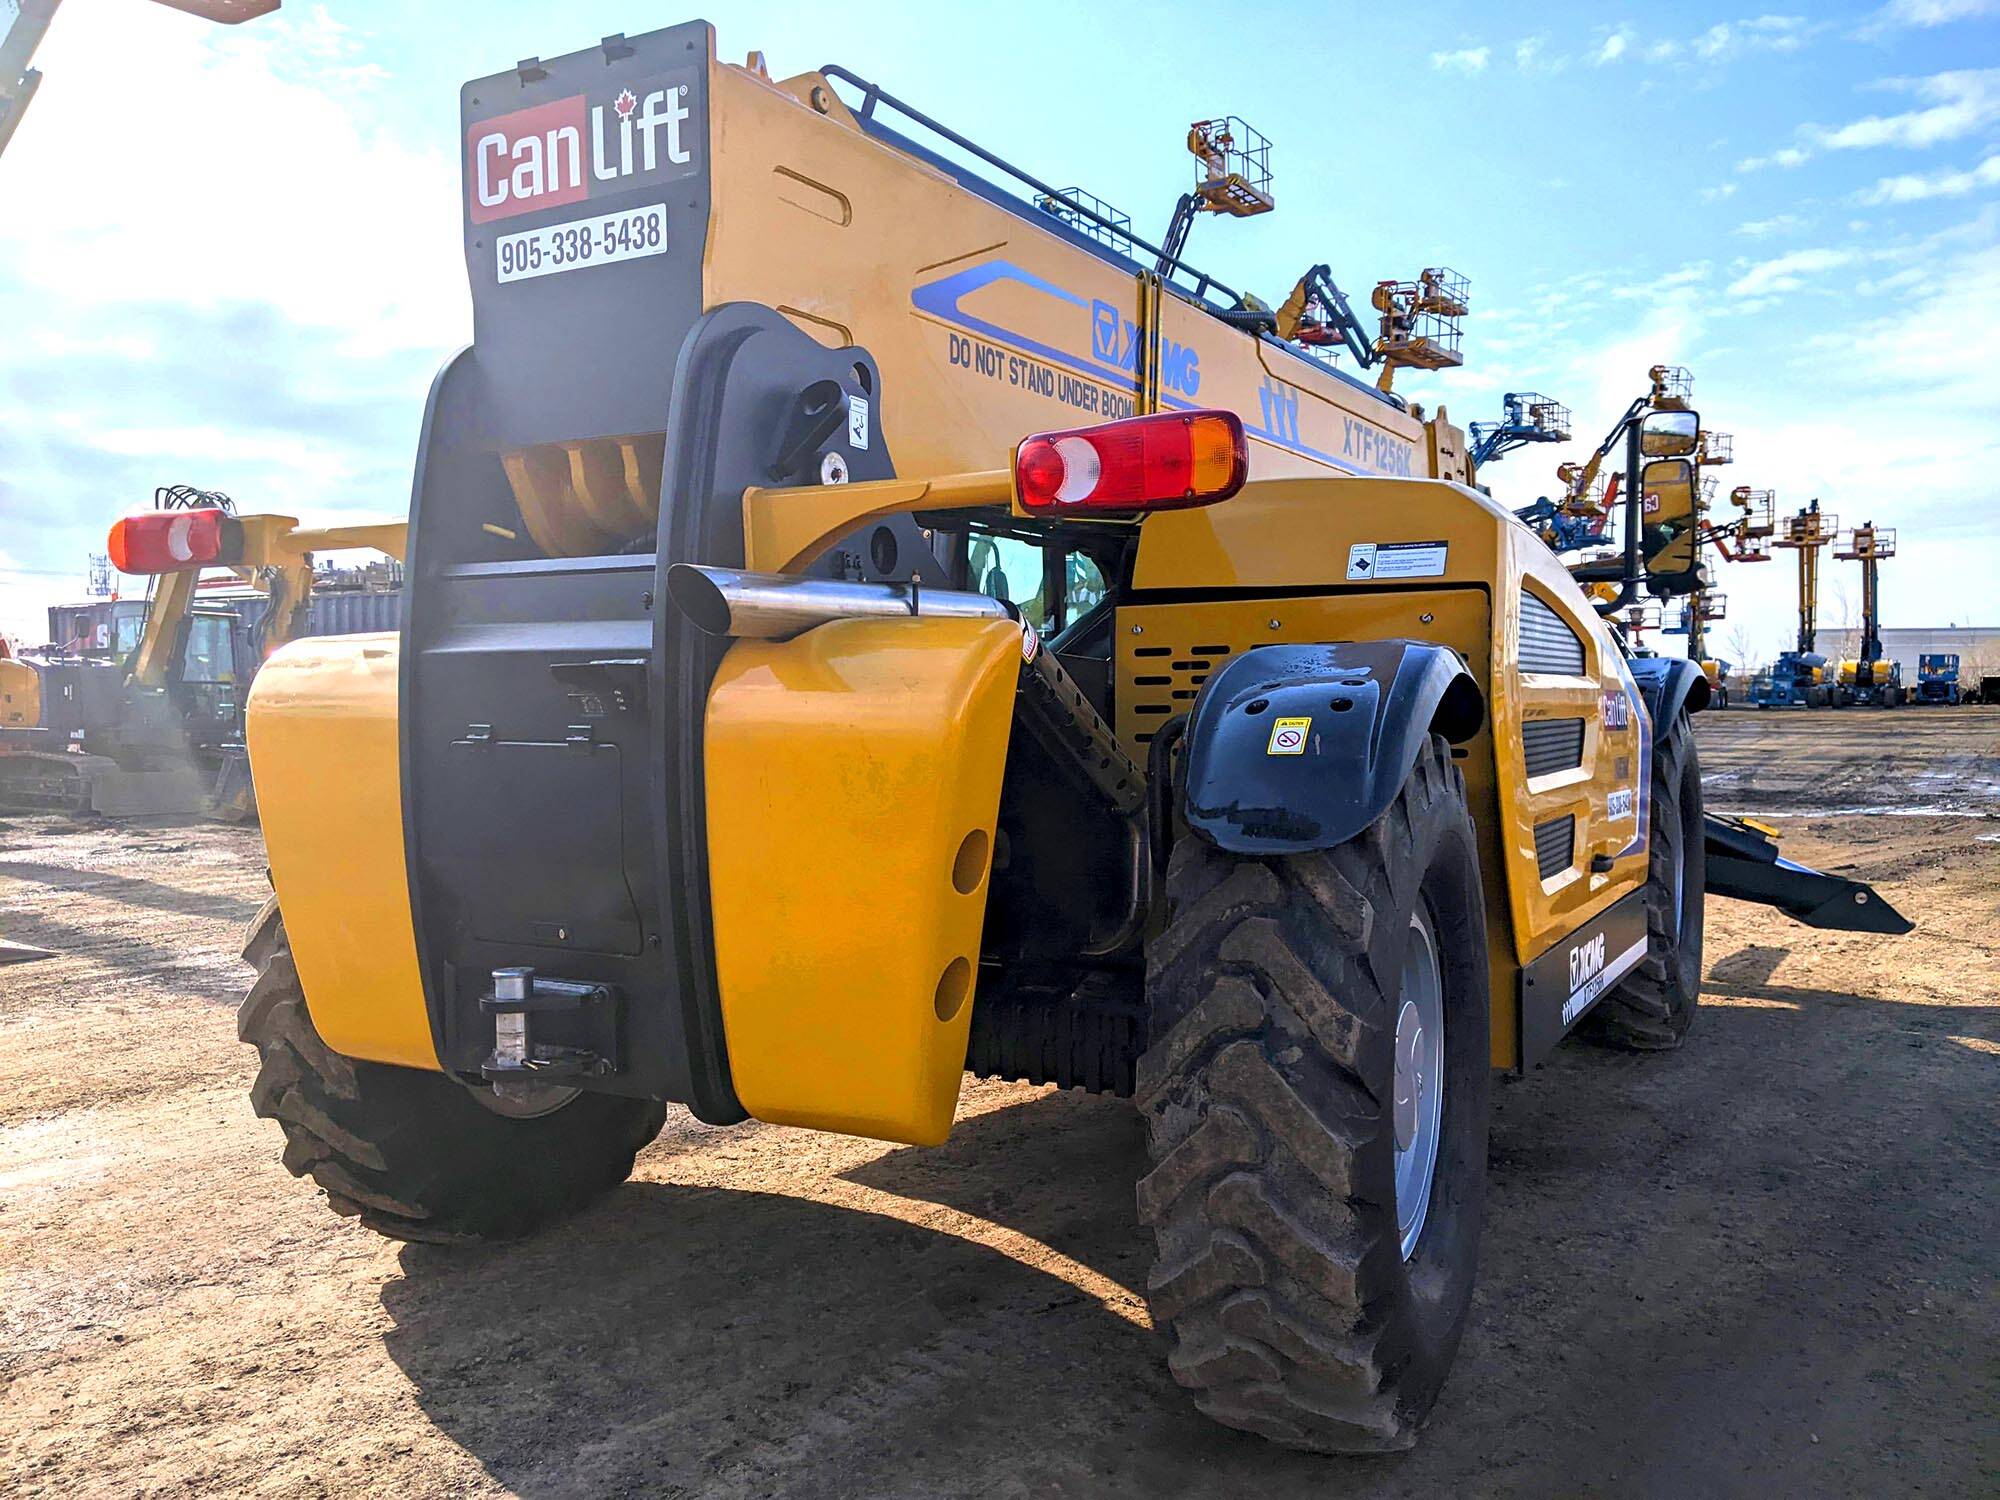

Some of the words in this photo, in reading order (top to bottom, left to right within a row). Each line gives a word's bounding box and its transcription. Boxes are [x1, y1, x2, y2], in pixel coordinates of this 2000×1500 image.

[502, 213, 660, 275] 905-338-5438
[949, 333, 971, 368] DO
[975, 343, 1005, 380] NOT
[1009, 356, 1054, 398] STAND
[1058, 373, 1098, 413] UNDER
